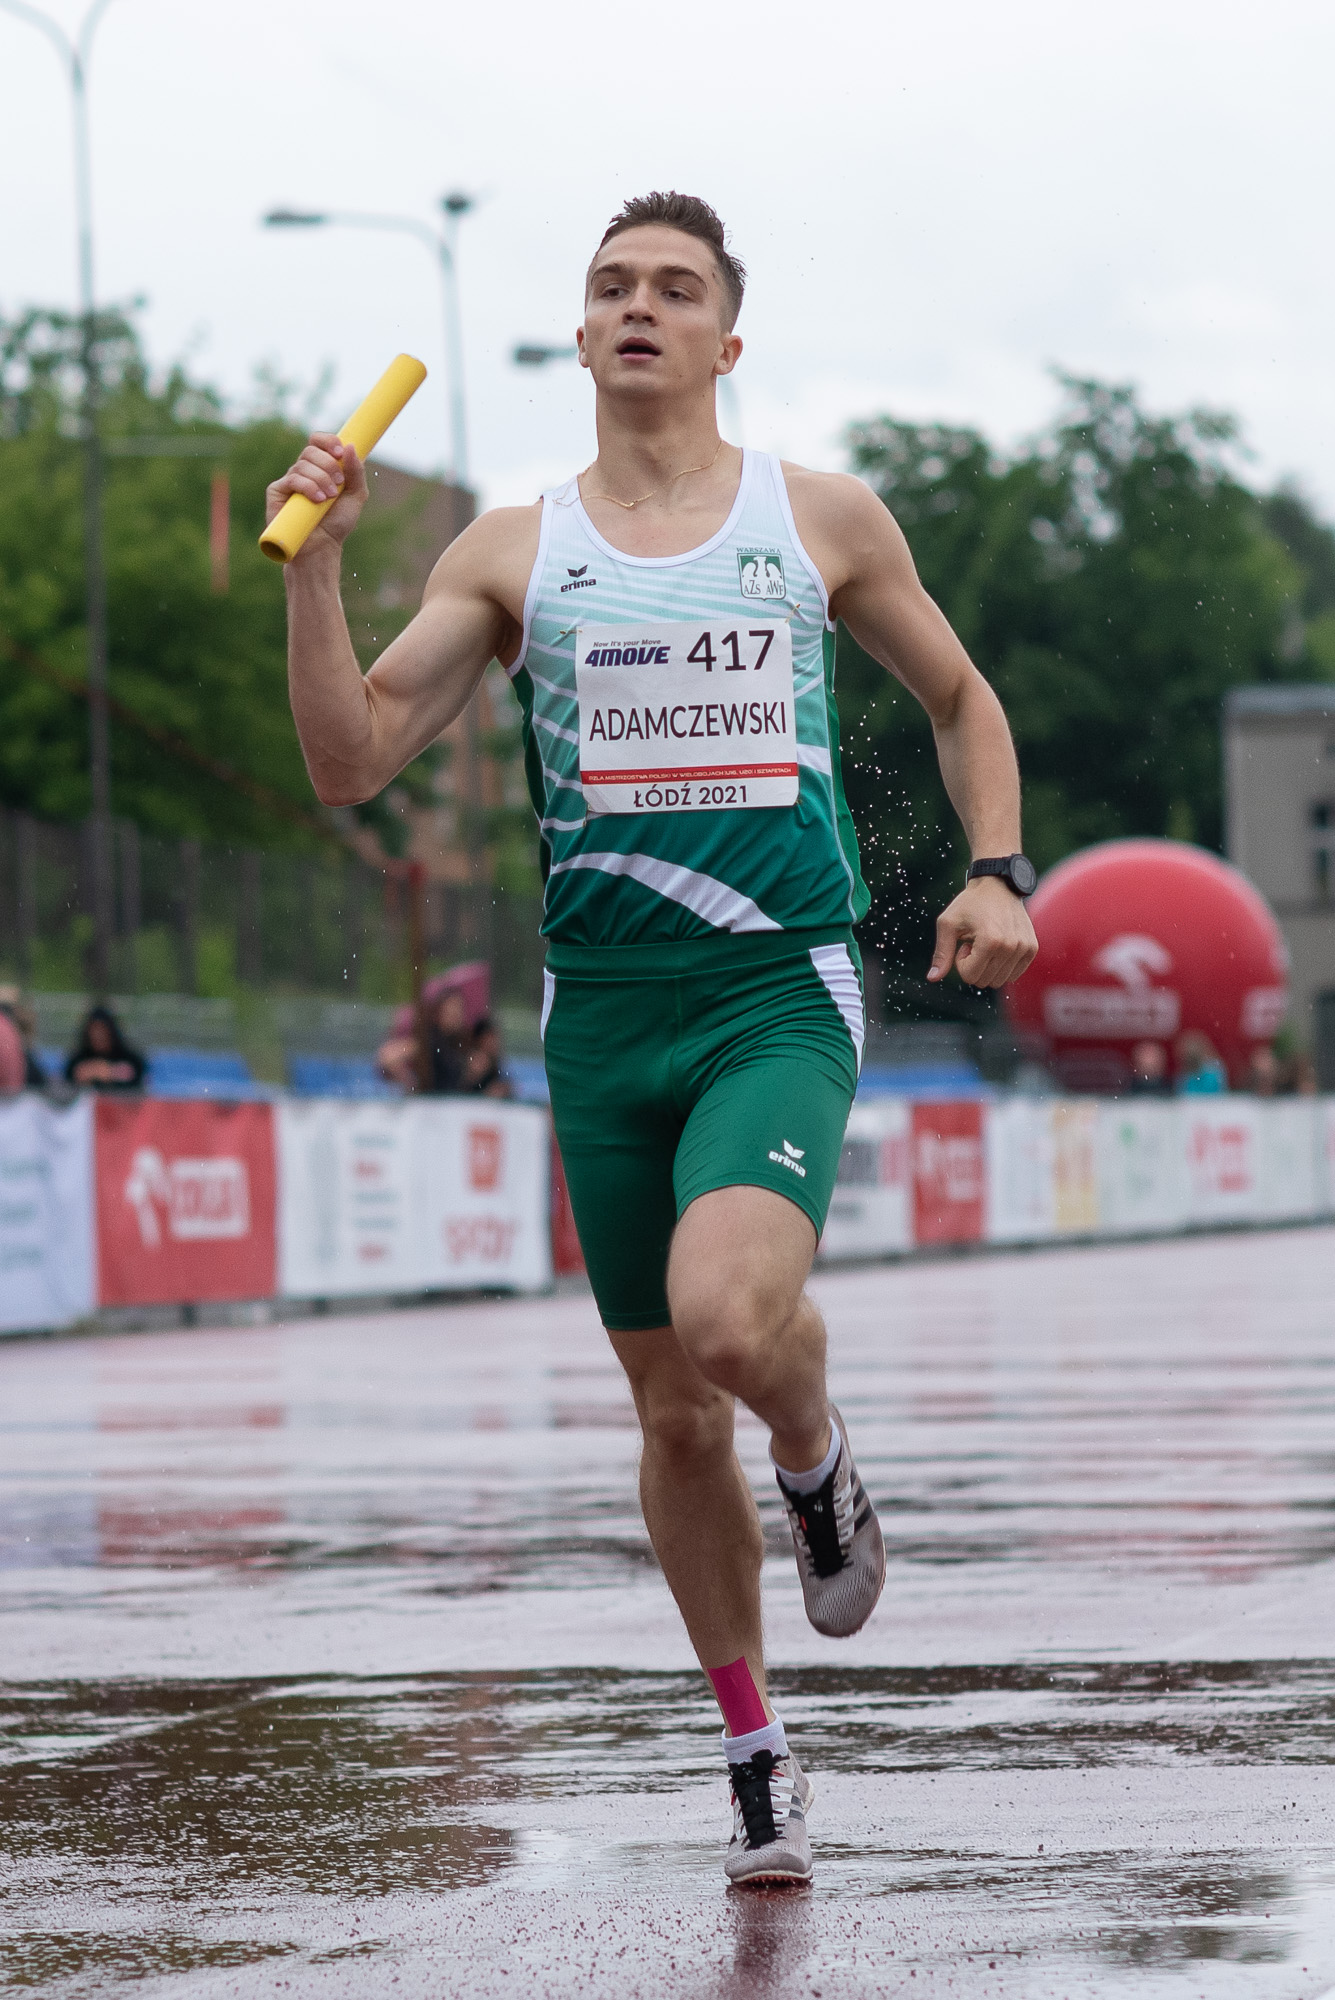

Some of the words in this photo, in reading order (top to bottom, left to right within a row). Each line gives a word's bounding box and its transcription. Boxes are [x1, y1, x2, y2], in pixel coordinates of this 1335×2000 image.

[561, 578, 597, 593] erima
[744, 580, 761, 595] AZS
[584, 646, 671, 667] 4MOVE
[687, 629, 775, 672] 417
[589, 701, 787, 742] ADAMCZEWSKI
[634, 783, 692, 808] ŁÓDŹ
[700, 786, 746, 805] 2021
[769, 1151, 806, 1177] erima
